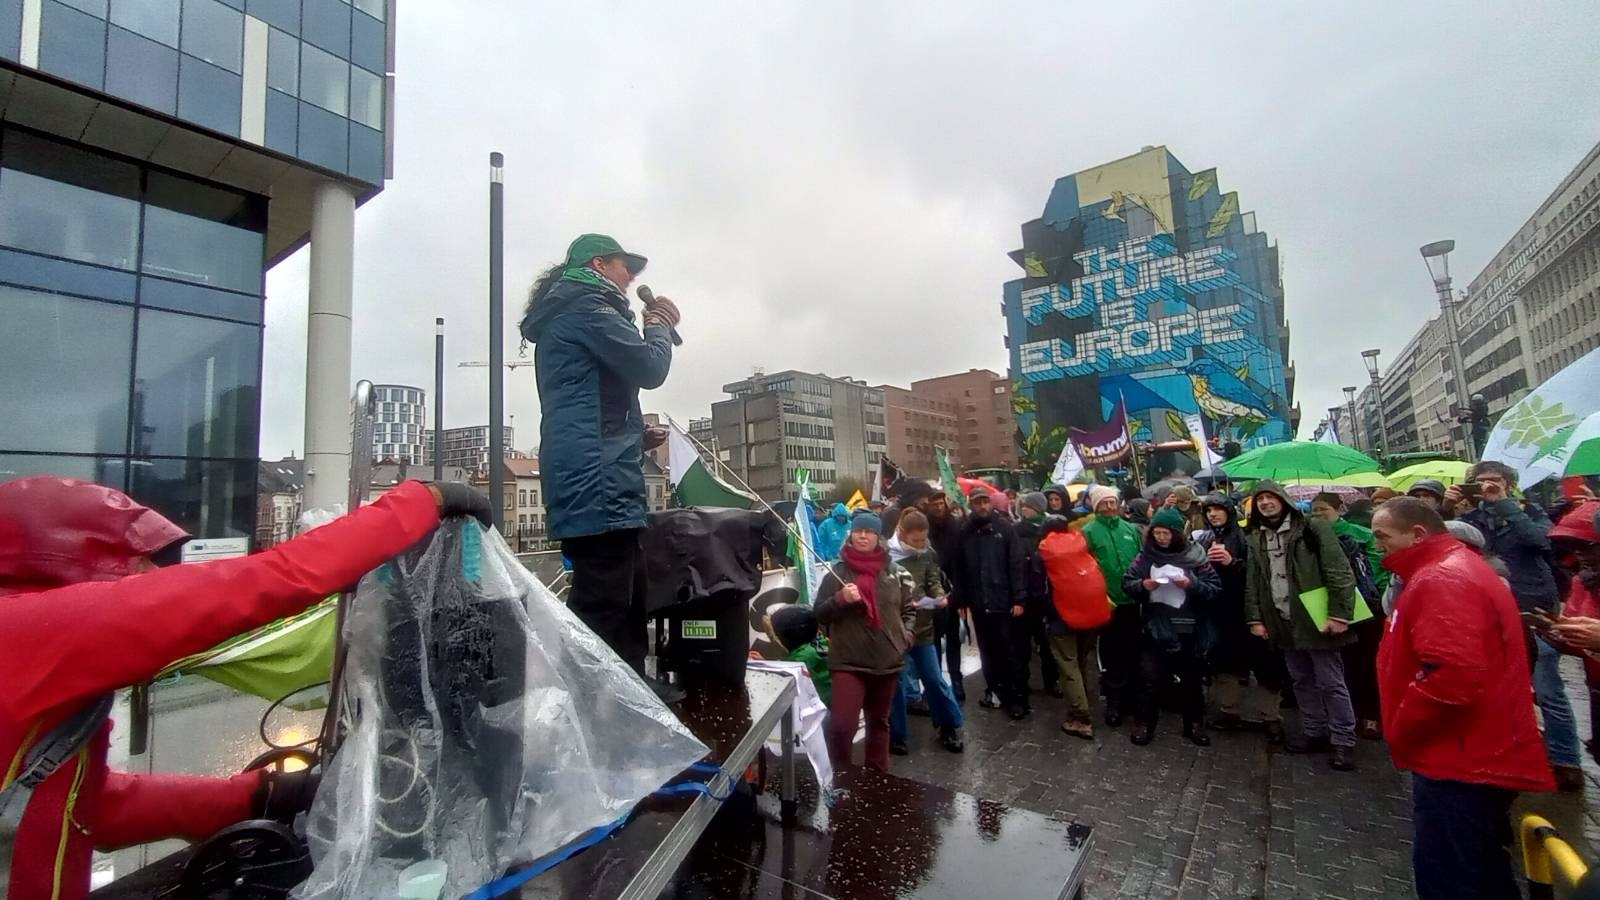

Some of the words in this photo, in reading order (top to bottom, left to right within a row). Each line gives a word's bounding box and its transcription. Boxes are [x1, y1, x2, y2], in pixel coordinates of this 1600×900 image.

[1021, 245, 1225, 319] FUTURE
[1073, 234, 1153, 274] THE
[1020, 303, 1244, 375] EUROPE
[1101, 299, 1136, 328] IS
